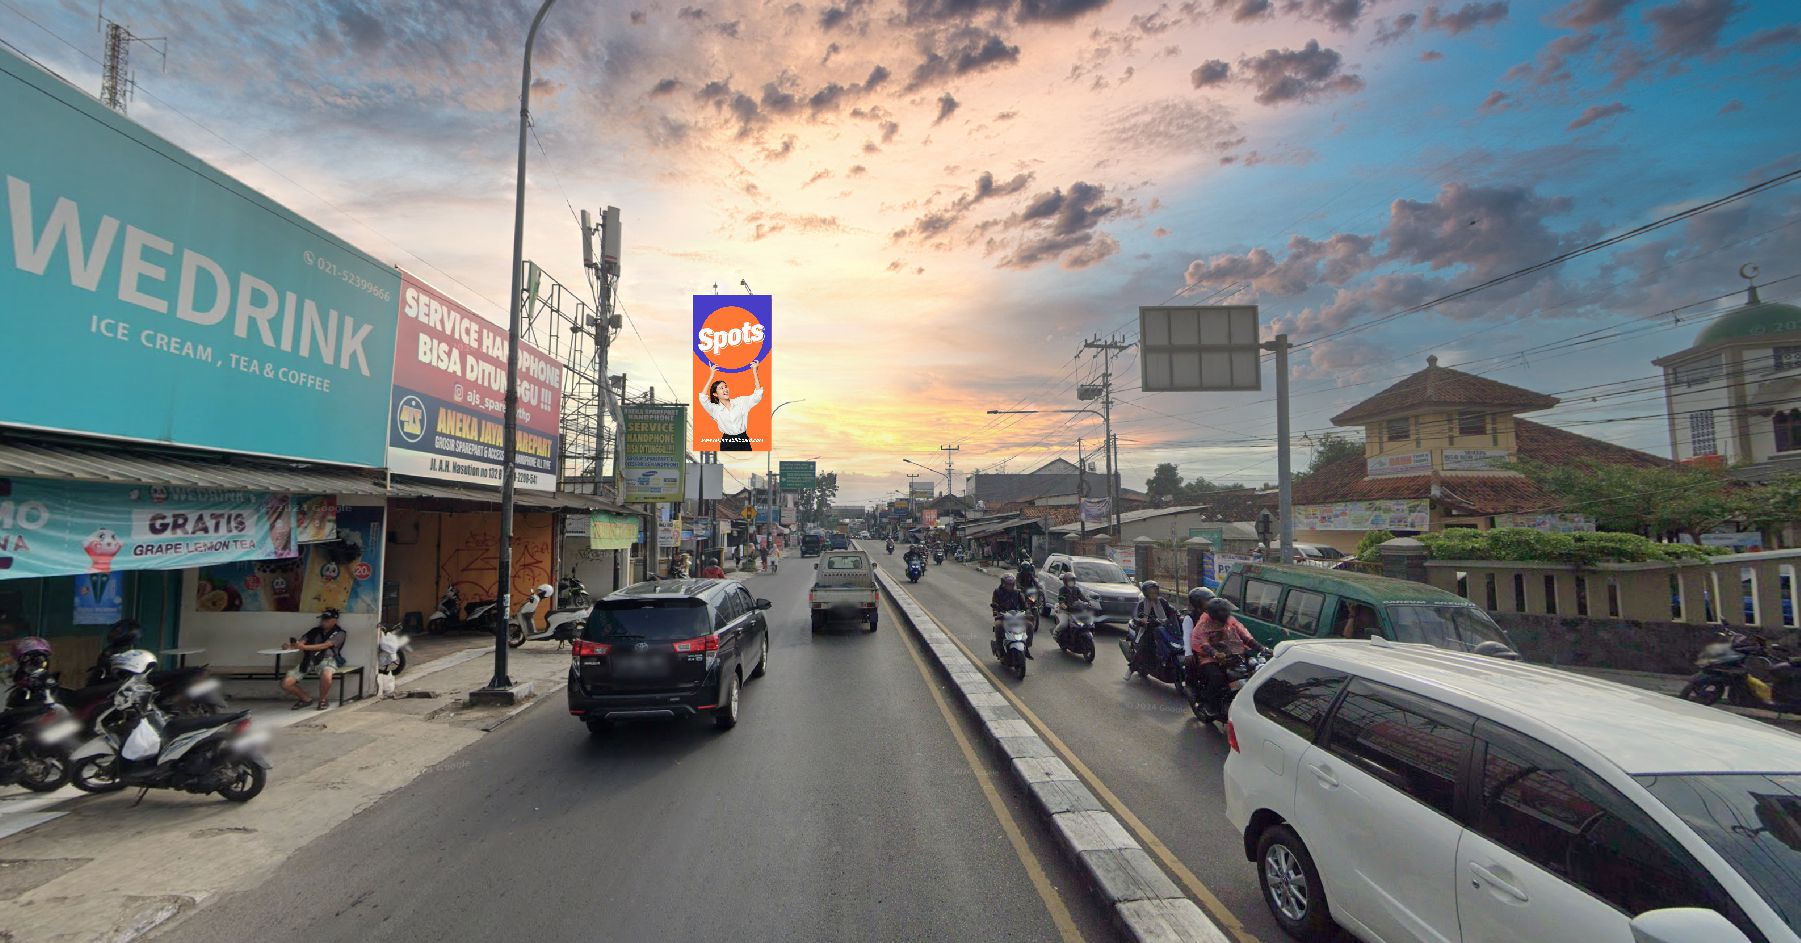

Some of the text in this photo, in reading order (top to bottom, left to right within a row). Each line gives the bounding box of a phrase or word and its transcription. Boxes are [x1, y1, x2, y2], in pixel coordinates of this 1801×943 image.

[6, 174, 375, 378] WEDRINK
[317, 258, 391, 302] 021-52399666
[404, 287, 480, 349] SERVICE
[90, 314, 130, 342] ICE
[229, 352, 261, 376] TEA
[263, 362, 275, 378] &
[278, 367, 332, 393] COFFEE
[697, 321, 766, 356] Spots
[418, 332, 462, 377] BISA
[540, 387, 552, 412] !!!
[436, 407, 479, 441] ANEKA
[480, 419, 503, 448] JAYA
[626, 433, 675, 443] HANDPHONE
[627, 422, 675, 432] SERVICE
[434, 435, 455, 452] GROSIR
[456, 440, 484, 457] SPAREPART
[452, 461, 480, 477] Nasution
[149, 512, 247, 536] GRATIS
[133, 539, 256, 557] GRAPE LEMON TEA
